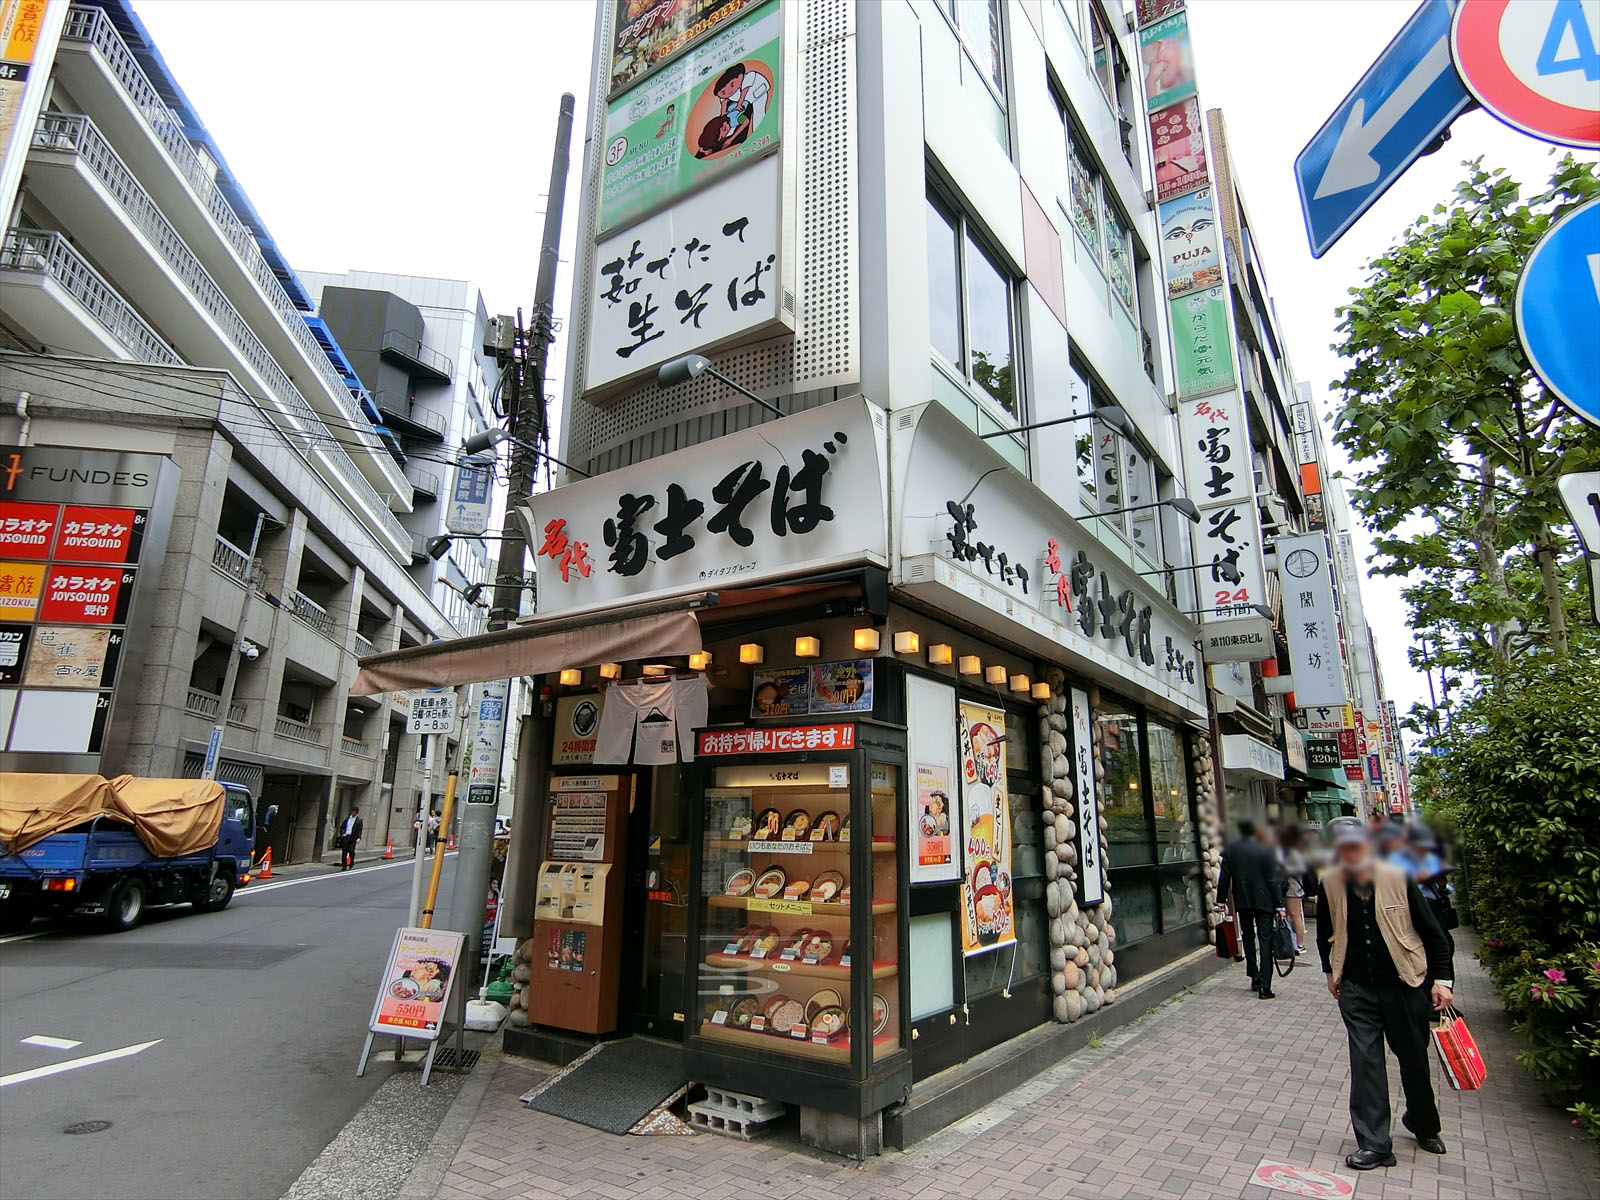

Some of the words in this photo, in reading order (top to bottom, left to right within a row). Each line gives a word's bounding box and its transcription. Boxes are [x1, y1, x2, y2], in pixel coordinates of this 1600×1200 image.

[13, 0, 44, 43] 貴族
[0, 65, 17, 79] 4F
[609, 141, 623, 163] 3F
[629, 139, 649, 155] MENU
[1197, 191, 1209, 201] 4F
[1172, 245, 1211, 264] PUJA
[1211, 289, 1221, 297] 3F
[615, 254, 776, 359] 生そば
[1191, 312, 1210, 345] からだ
[1196, 355, 1215, 377] 元気
[1192, 401, 1229, 424] 名代
[30, 466, 149, 487] FUNDES
[537, 518, 592, 583] 名代
[603, 431, 848, 577] 富士そば
[134, 514, 146, 525] 8F
[63, 521, 128, 536] カラオケ
[63, 536, 122, 549] JOYSOUND
[51, 575, 117, 591] カラオケ
[122, 573, 134, 584] 6F
[51, 591, 110, 603] JOYSOUND
[1046, 538, 1073, 613] 名代
[1072, 550, 1154, 667] 富士そば
[1215, 588, 1250, 605] 24
[84, 605, 109, 616] 受付
[109, 634, 122, 645] 4F
[1210, 633, 1263, 648] 第110東京ビル
[788, 684, 808, 695] そば
[97, 698, 109, 708] 2F
[1312, 754, 1338, 764] 320円
[1078, 745, 1095, 868] 富士そば
[768, 902, 811, 912] セットメニュー
[395, 1003, 426, 1019] 550円
